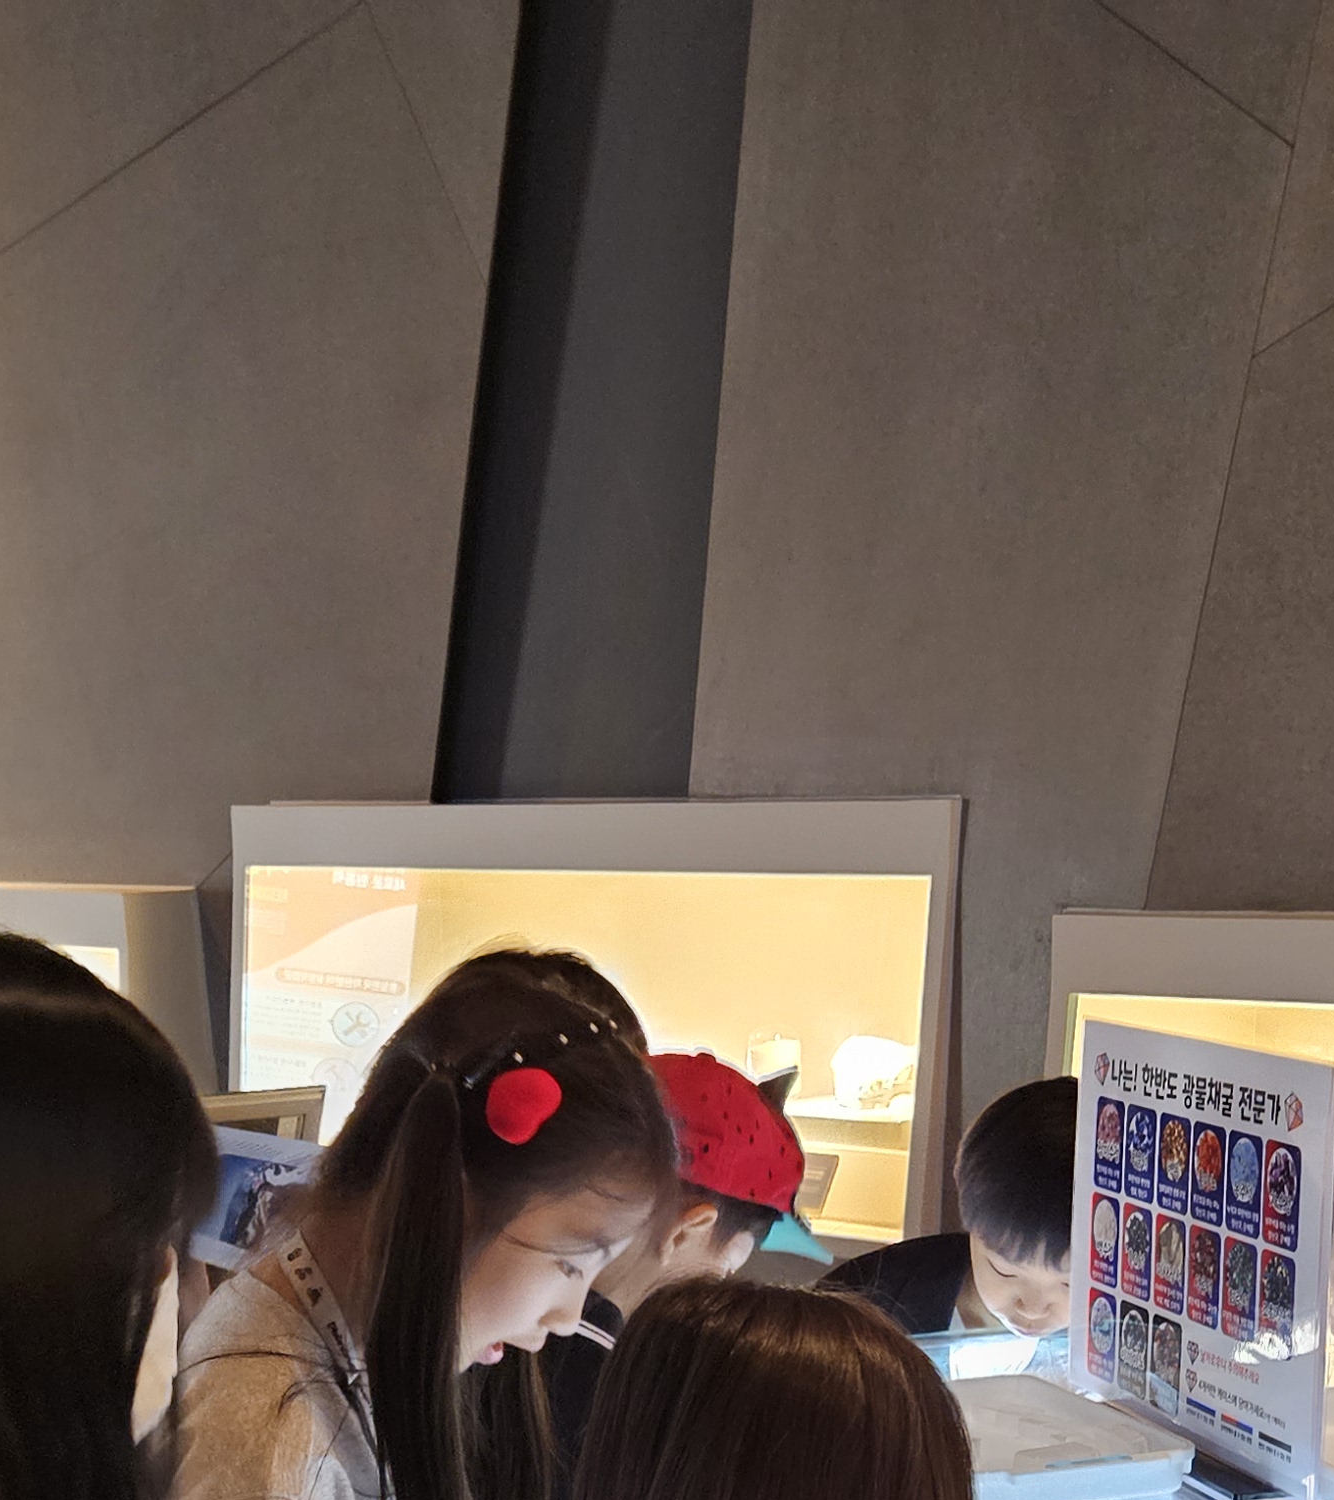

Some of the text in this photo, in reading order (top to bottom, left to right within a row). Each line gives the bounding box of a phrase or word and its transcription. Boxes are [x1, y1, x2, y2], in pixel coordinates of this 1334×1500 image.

[1111, 1058, 1282, 1126] 나는! 한반도 광물채굴 전문가
